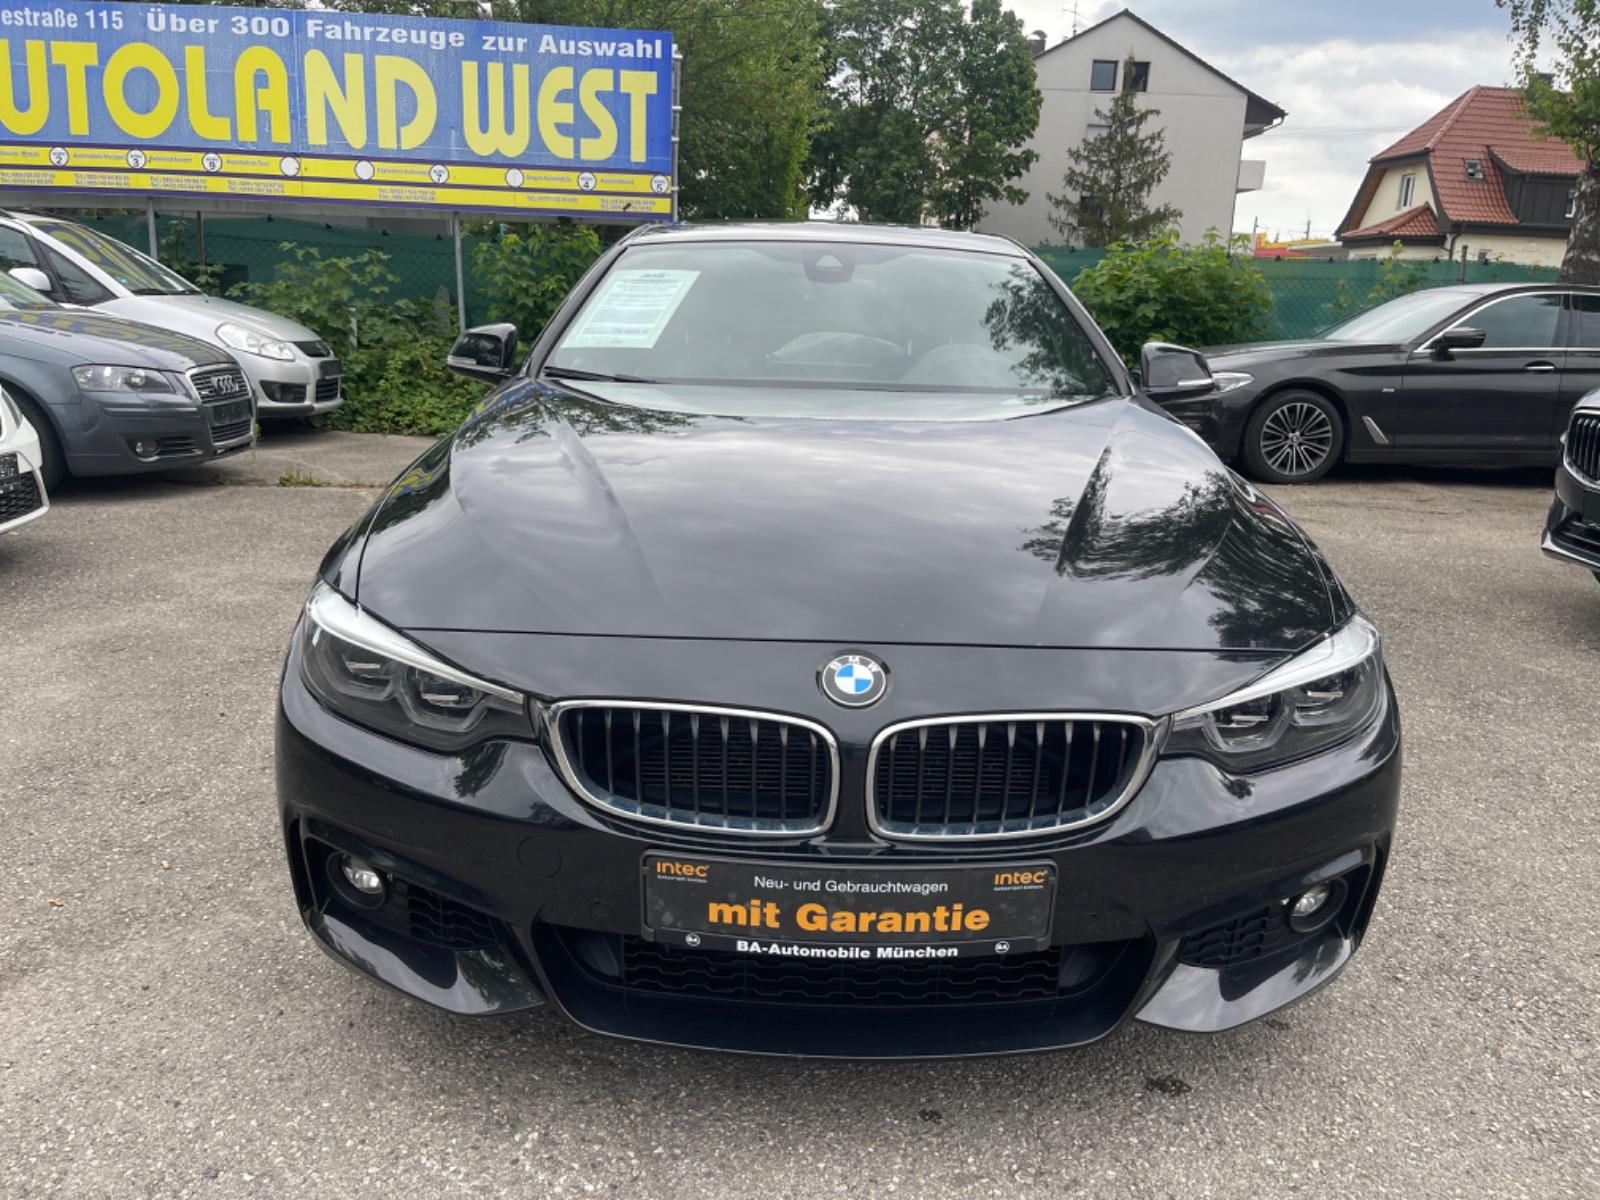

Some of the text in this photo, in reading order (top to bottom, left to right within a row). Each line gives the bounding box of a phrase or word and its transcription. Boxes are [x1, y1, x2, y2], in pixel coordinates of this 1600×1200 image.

[0, 7, 124, 30] estraße 115
[146, 8, 662, 59] Über 300 Fahrzeuge zur Auswahl
[461, 60, 658, 163] WEST
[753, 875, 948, 895] Neu- und Gebrauchtwagen
[708, 899, 990, 933] mit Garantie
[736, 940, 958, 959] BA-Automobile München
